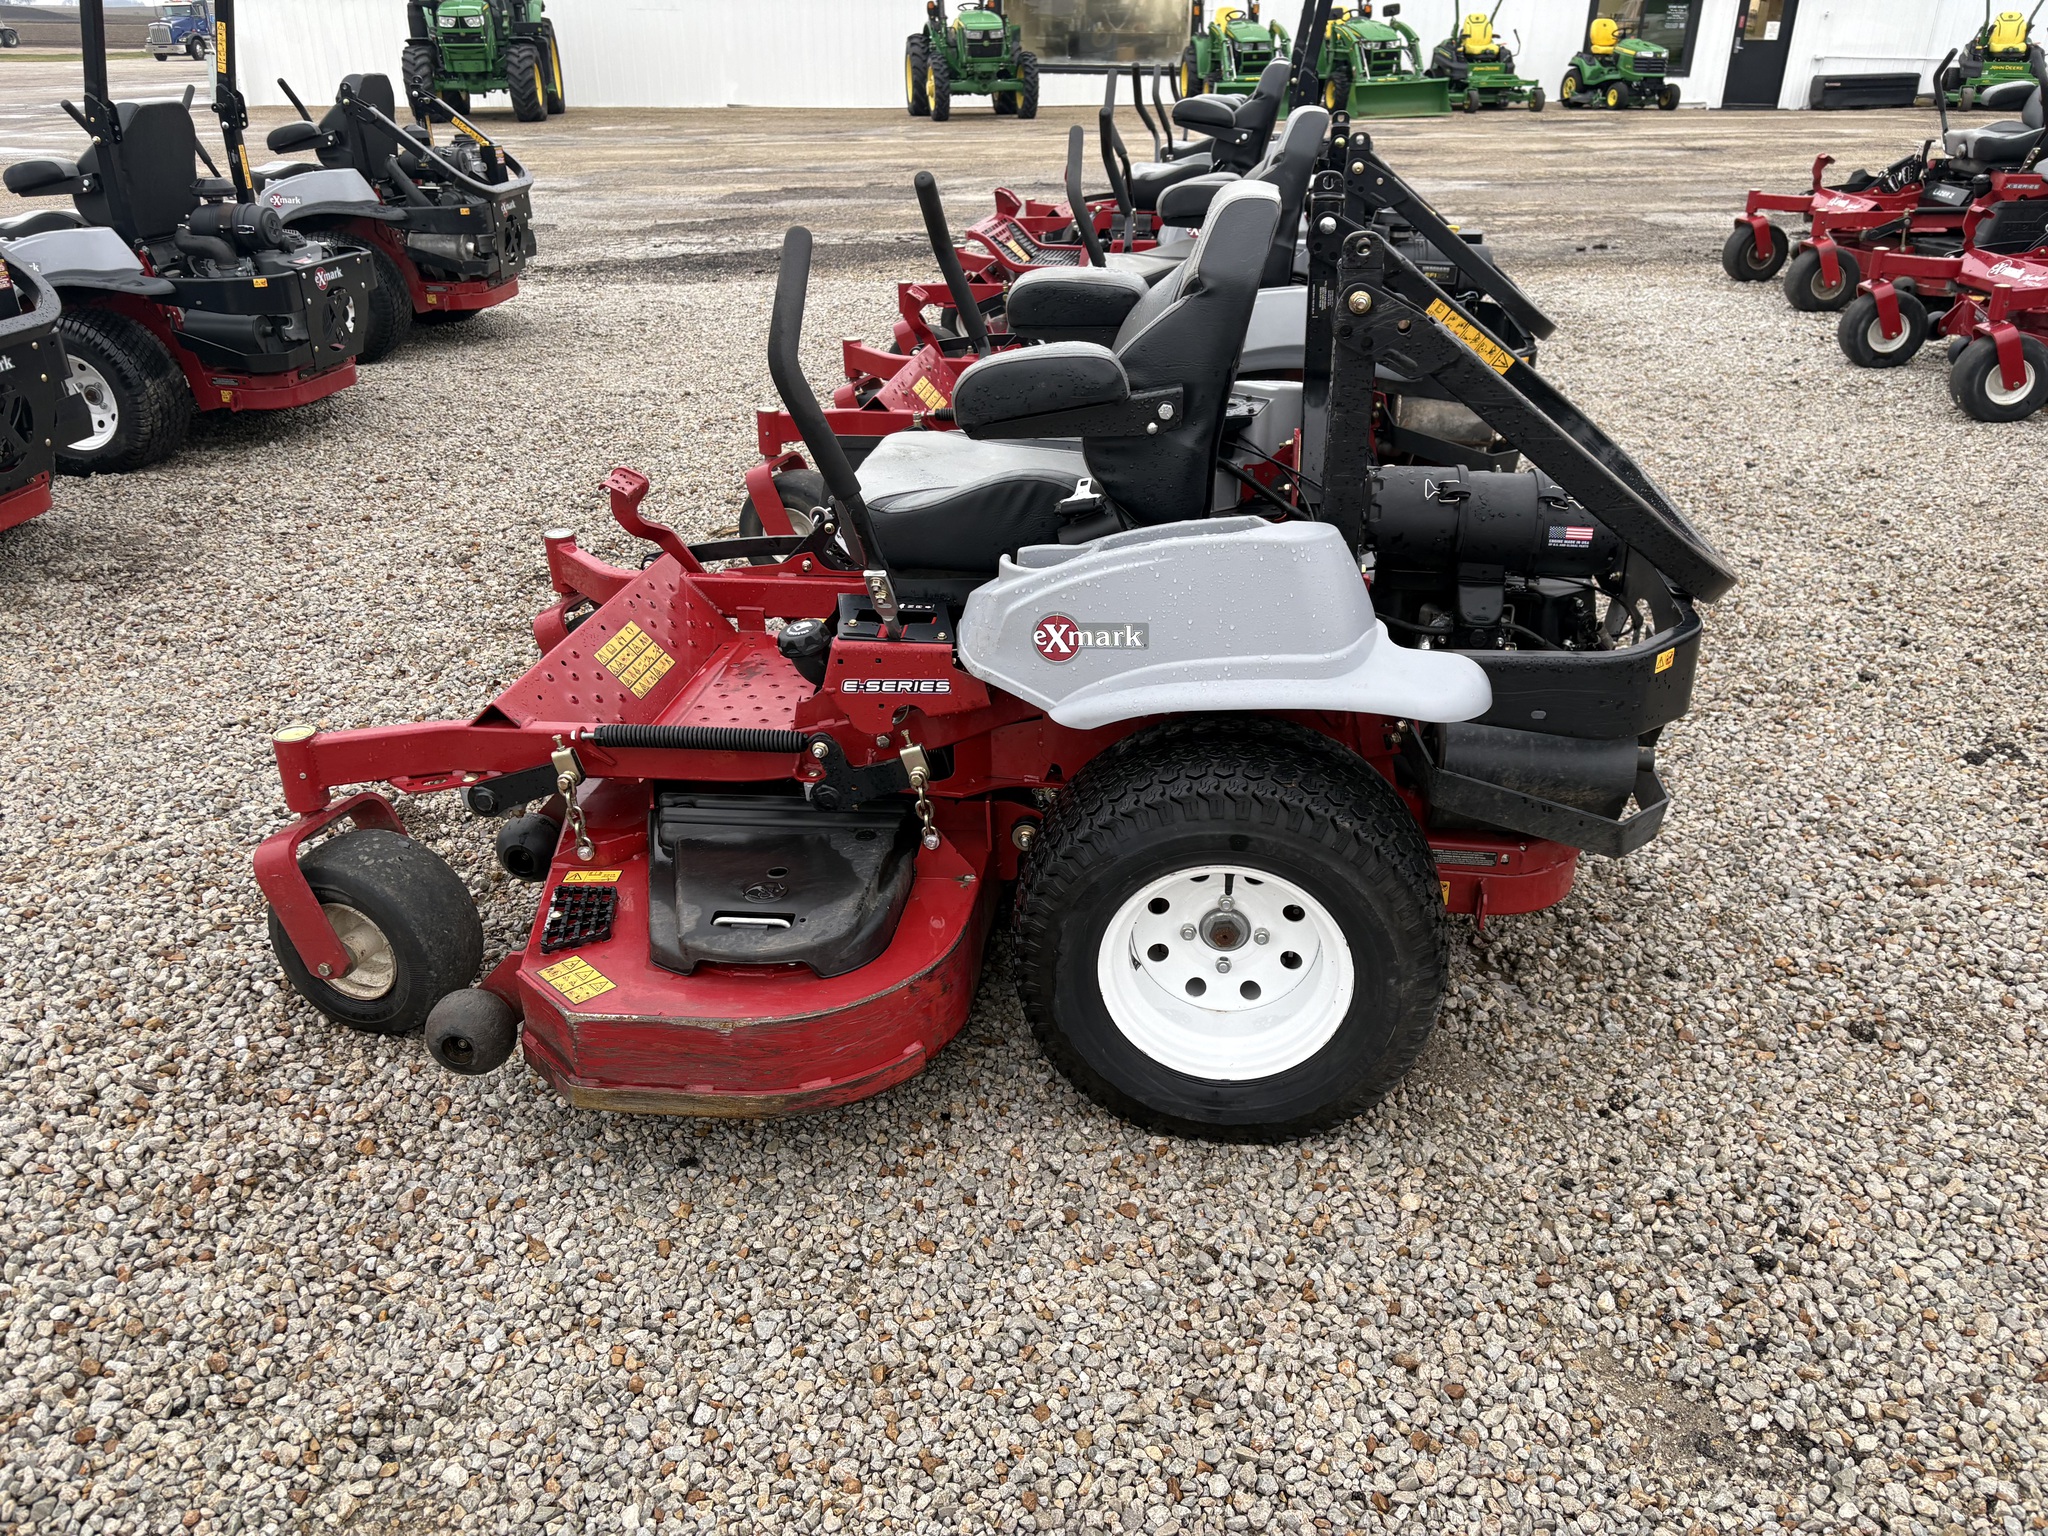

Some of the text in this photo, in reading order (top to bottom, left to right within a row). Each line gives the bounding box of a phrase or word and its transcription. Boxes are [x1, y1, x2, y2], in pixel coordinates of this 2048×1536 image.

[1932, 188, 1950, 198] LAZER
[1033, 624, 1143, 653] eXmark
[842, 679, 952, 693] E-SERIES
